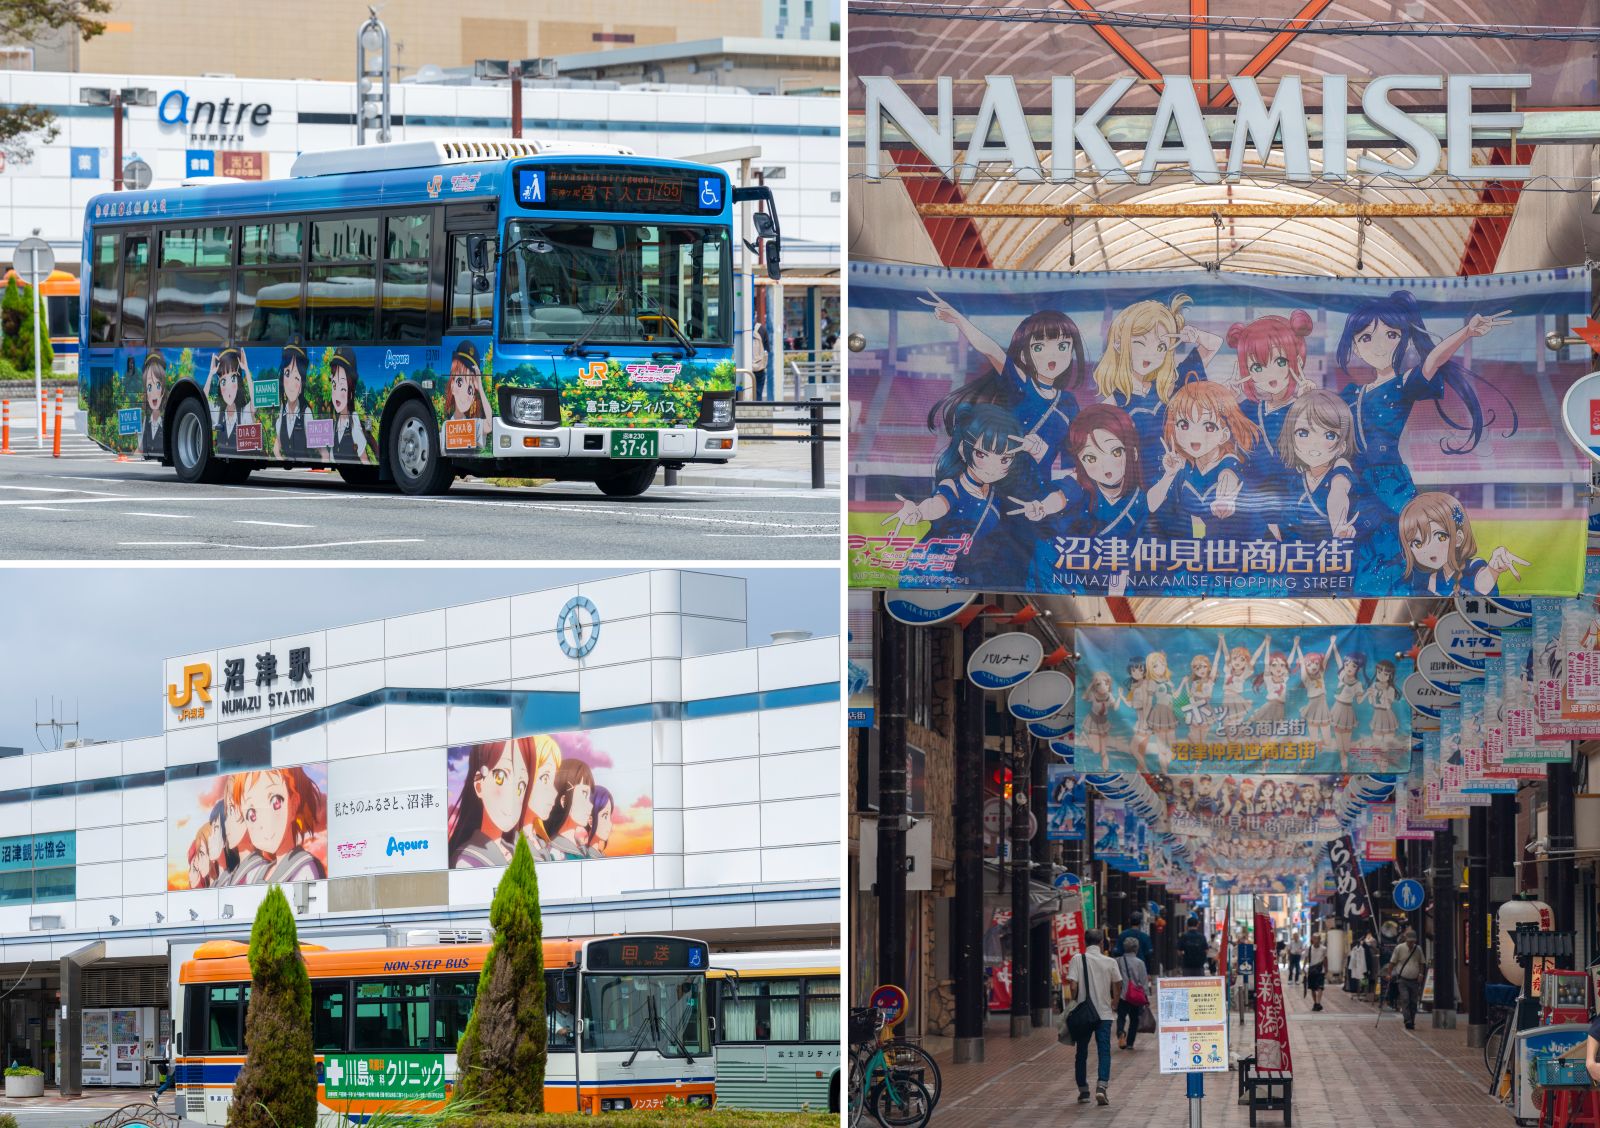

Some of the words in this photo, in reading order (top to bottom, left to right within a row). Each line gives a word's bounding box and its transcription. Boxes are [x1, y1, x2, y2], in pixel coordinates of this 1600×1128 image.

[158, 89, 272, 126] antre
[191, 133, 245, 142] numazu
[858, 74, 1532, 185] NAKAMISE
[581, 184, 653, 202] 宮下入口
[656, 182, 679, 197] 755
[579, 362, 608, 380] JR
[586, 400, 676, 413] 富士急シティバス
[448, 423, 467, 435] CHIKA
[619, 440, 655, 456] 37-61
[1053, 535, 1355, 574] 沼津仲見世商店街
[1052, 572, 1120, 588] NUMAZU
[1125, 574, 1209, 588] NAKAMISE
[1214, 575, 1297, 589] SHOPPING
[1303, 576, 1355, 589] STREET
[224, 646, 313, 693] 沼津駅
[168, 663, 213, 708] JR
[221, 695, 262, 715] NUMAZU
[268, 686, 315, 708] STATION
[178, 706, 205, 722] JR東海
[1214, 719, 1307, 738] とする商店街
[1171, 742, 1317, 761] 沼津仲見世商店街
[335, 792, 440, 818] 私たちのふるさと、沼津。
[2, 840, 66, 864] 沼津観光協会
[385, 836, 429, 857] Aqours
[1330, 839, 1366, 918] らーめん
[622, 945, 670, 960] 回送
[383, 959, 442, 972] NON-STEP
[445, 957, 470, 969] BUS
[1257, 971, 1280, 1037] 新潟
[345, 1059, 369, 1086] 川島
[386, 1059, 443, 1087] クリニック
